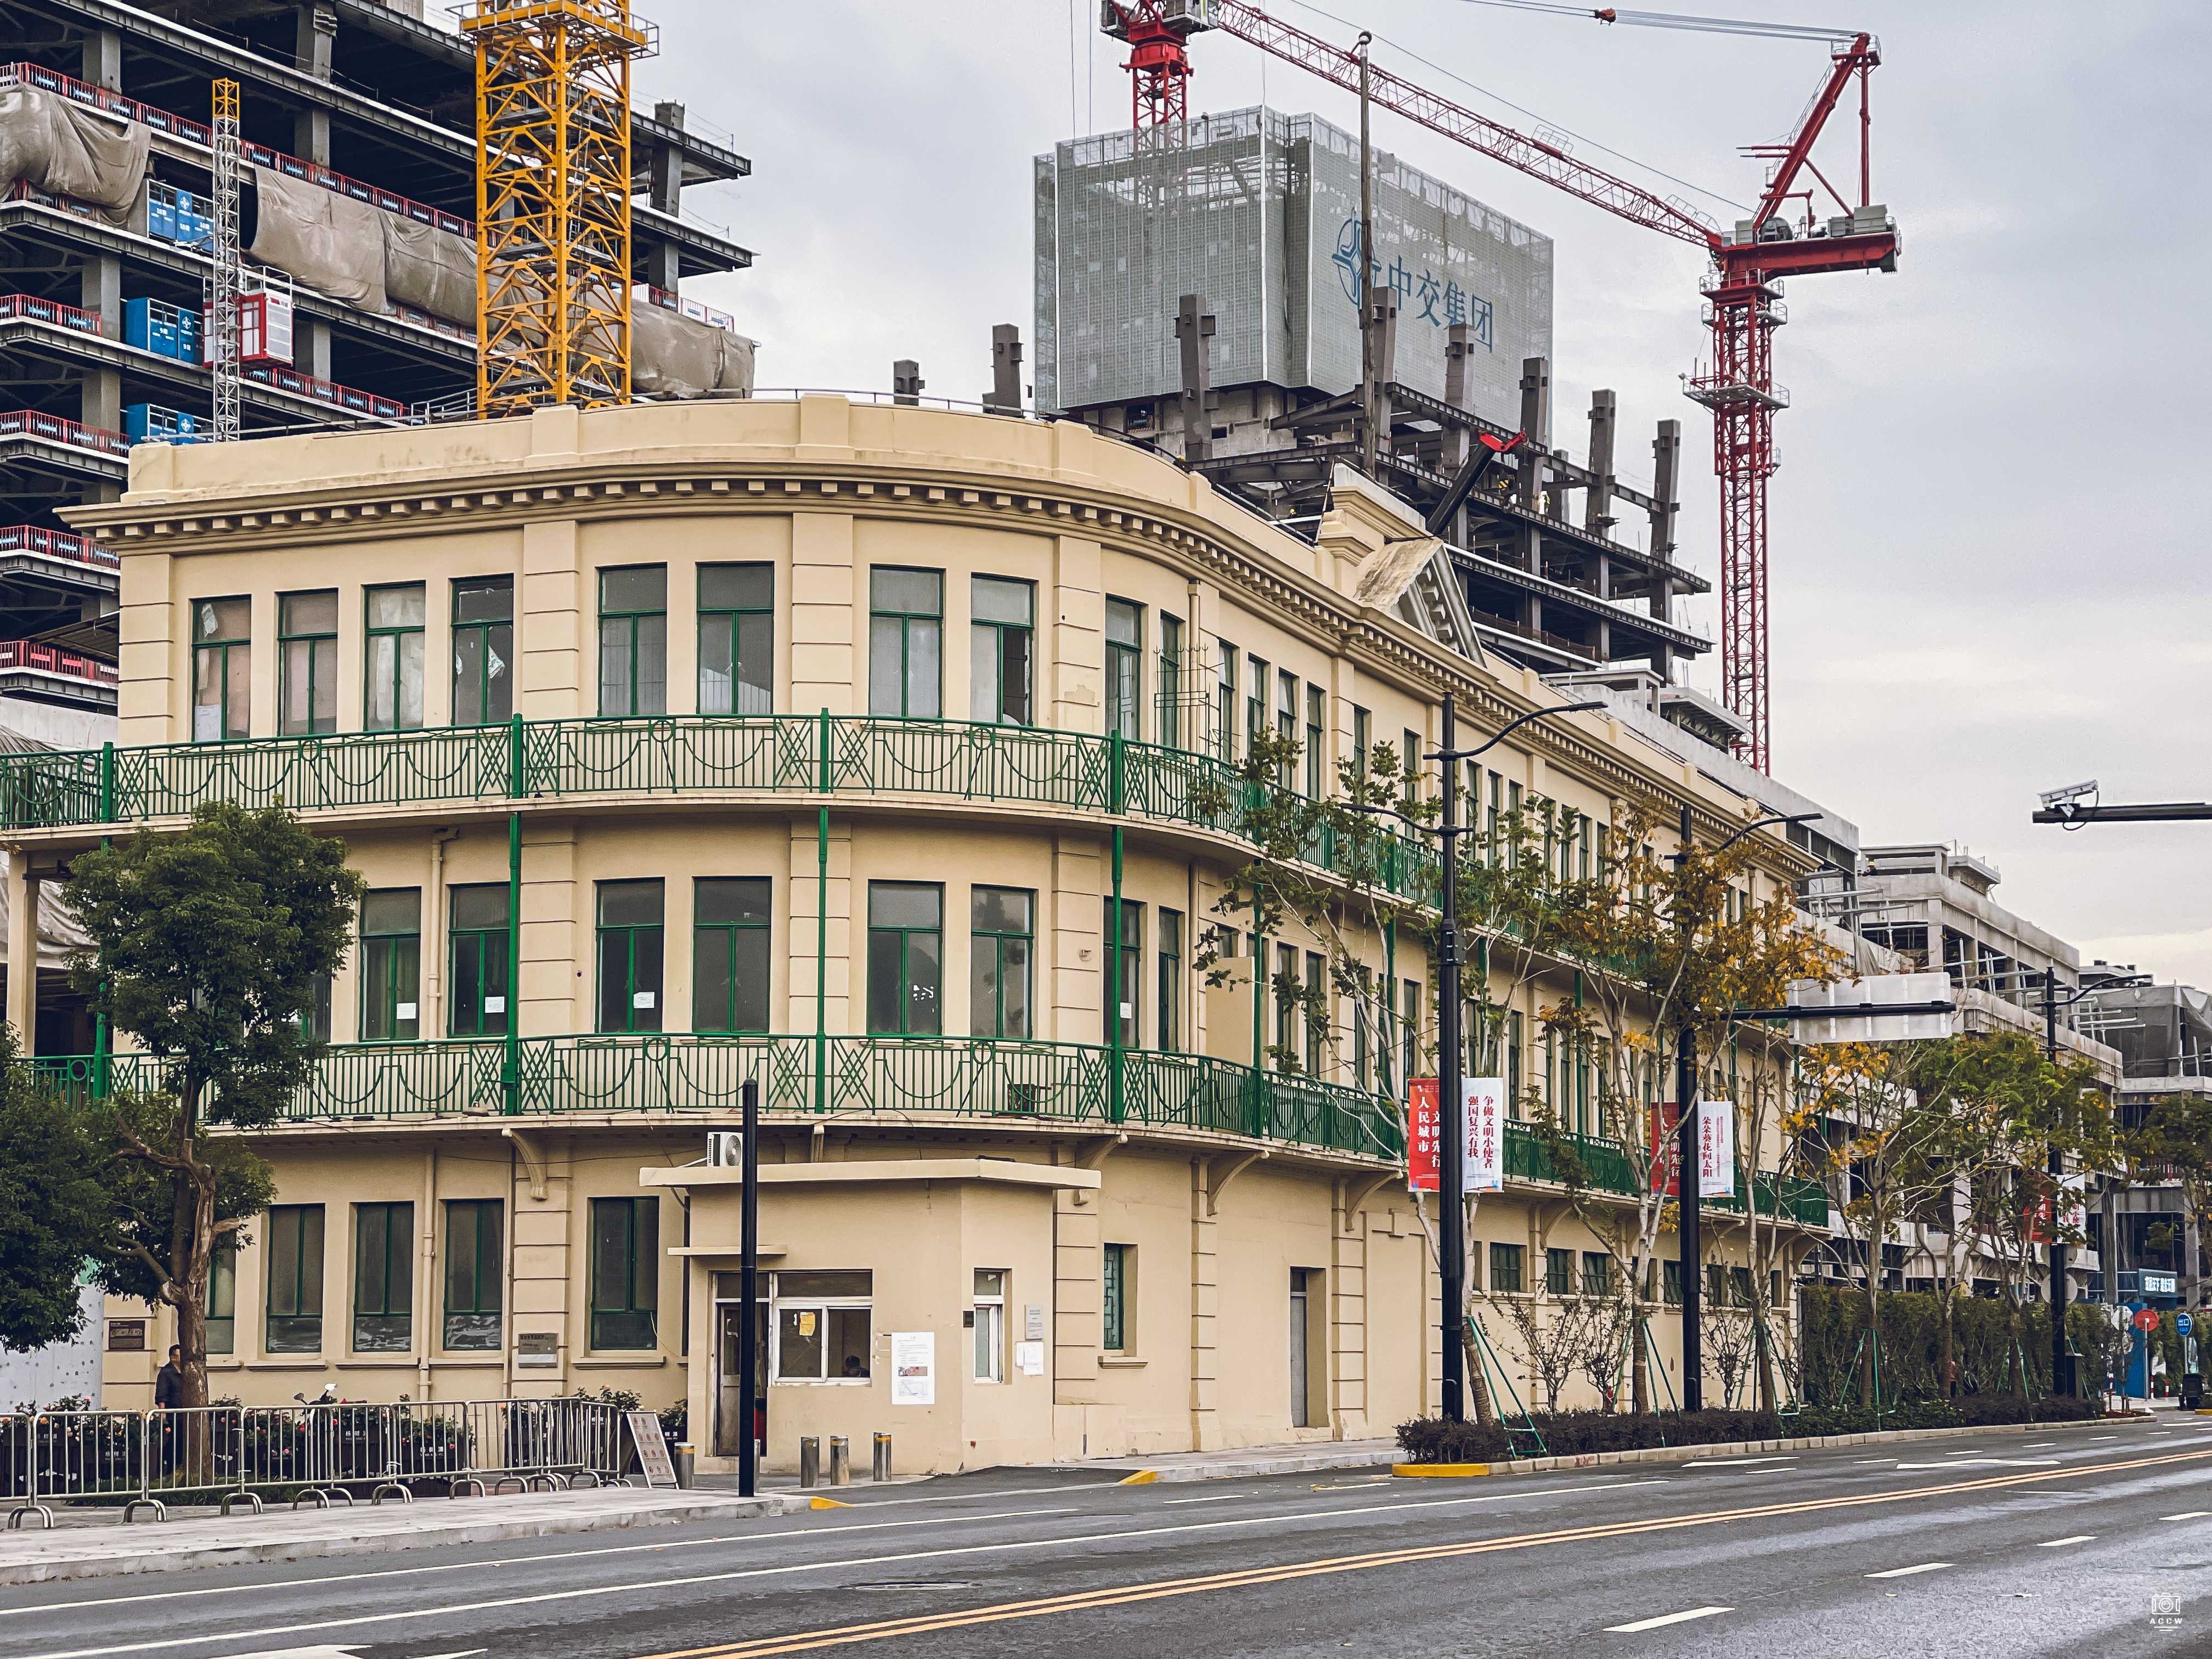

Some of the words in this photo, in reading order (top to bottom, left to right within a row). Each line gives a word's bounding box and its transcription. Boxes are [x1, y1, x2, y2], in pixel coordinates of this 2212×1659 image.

[1389, 255, 1493, 353] 中交集团
[1418, 1096, 1430, 1153] 人民城市
[1468, 1096, 1479, 1158] 强国复兴有我
[1483, 1096, 1494, 1169] 争做文明小使者
[1702, 1116, 1712, 1177] 朵朵葵花向太阳
